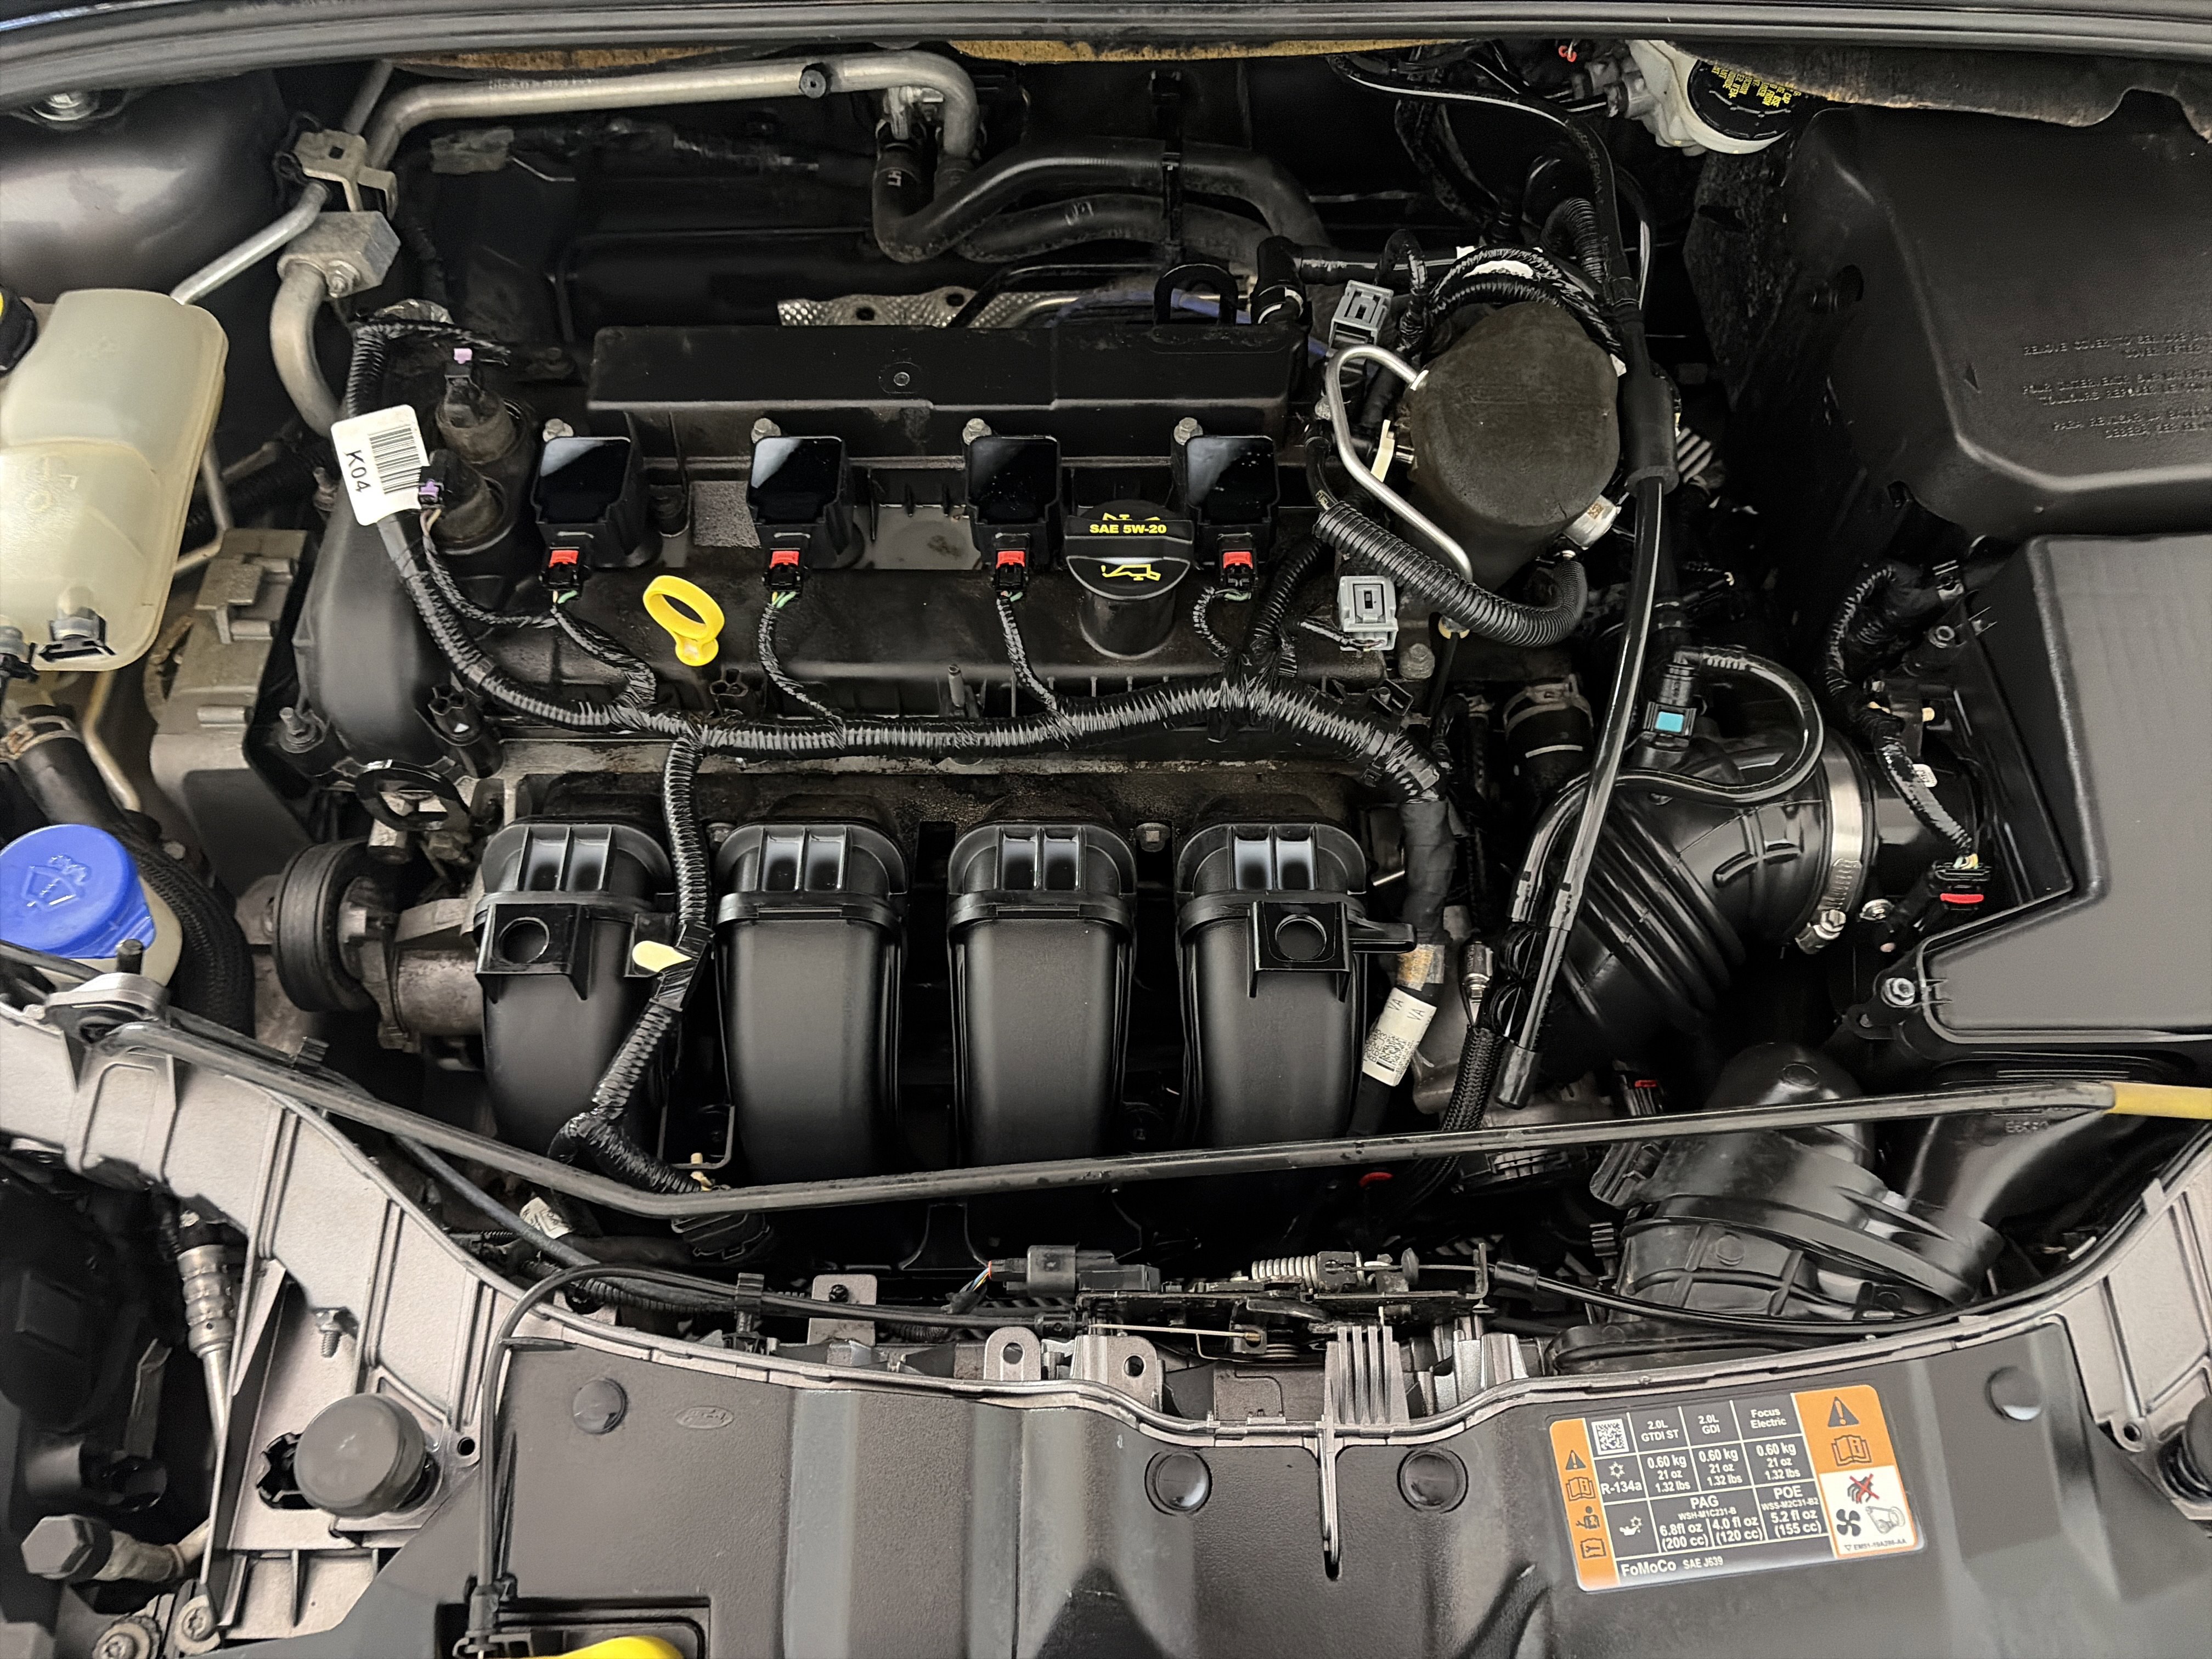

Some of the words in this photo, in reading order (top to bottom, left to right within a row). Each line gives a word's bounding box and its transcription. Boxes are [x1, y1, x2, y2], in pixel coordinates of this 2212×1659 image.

[343, 450, 371, 493] K04
[1316, 491, 1329, 507] FUEL
[1090, 523, 1119, 534] SAE
[1122, 523, 1167, 535] 5W-20
[1387, 999, 1404, 1011] VA
[1407, 1008, 1425, 1021] VA
[1698, 1414, 1719, 1425] 2.0L
[1750, 1408, 1781, 1418] Focus
[1647, 1420, 1668, 1430] 2.0L
[1702, 1424, 1720, 1434] GDI
[1750, 1418, 1787, 1429] Electric
[1641, 1431, 1666, 1442] GTDI
[1667, 1429, 1679, 1439] ST
[1699, 1449, 1722, 1463] 0.60
[1723, 1448, 1739, 1462] kg
[1756, 1443, 1780, 1457] 0.60
[1781, 1442, 1797, 1456] kg
[1647, 1455, 1670, 1469] 0.60
[1672, 1454, 1688, 1468] kg
[1766, 1457, 1779, 1468] 21
[1780, 1458, 1793, 1466] oz
[1657, 1470, 1669, 1480] 21
[1671, 1470, 1683, 1479] oz
[1708, 1464, 1720, 1474] 21
[1722, 1464, 1735, 1472] oz
[1764, 1470, 1785, 1481] 1.32
[1785, 1468, 1801, 1478] lbs
[1655, 1482, 1675, 1493] 1.32
[1676, 1481, 1691, 1491] lbs
[1707, 1476, 1727, 1487] 1.32
[1728, 1474, 1743, 1484] lbs
[1600, 1480, 1643, 1495] R-134a
[1773, 1485, 1803, 1499] POE
[1690, 1495, 1719, 1509] PAG
[1761, 1497, 1819, 1511] WSS-M2C31-B2
[1678, 1506, 1737, 1521] WSH-M1C231-B
[1770, 1510, 1790, 1523] 5.2
[1791, 1509, 1800, 1521] fl
[1802, 1510, 1818, 1520] oz
[1688, 1523, 1703, 1533] oz
[1712, 1517, 1730, 1530] 4.0
[1731, 1516, 1742, 1528] fl
[1743, 1517, 1759, 1527] oz
[1774, 1522, 1801, 1538] (155
[1803, 1520, 1822, 1534] cc)
[1662, 1536, 1688, 1552] (200
[1690, 1533, 1709, 1548] cc)
[1716, 1530, 1742, 1546] (120
[1744, 1527, 1763, 1541] cc)
[1620, 1559, 1677, 1578] FoMoCo
[1682, 1558, 1702, 1570] SAE
[1703, 1556, 1724, 1567] J639
